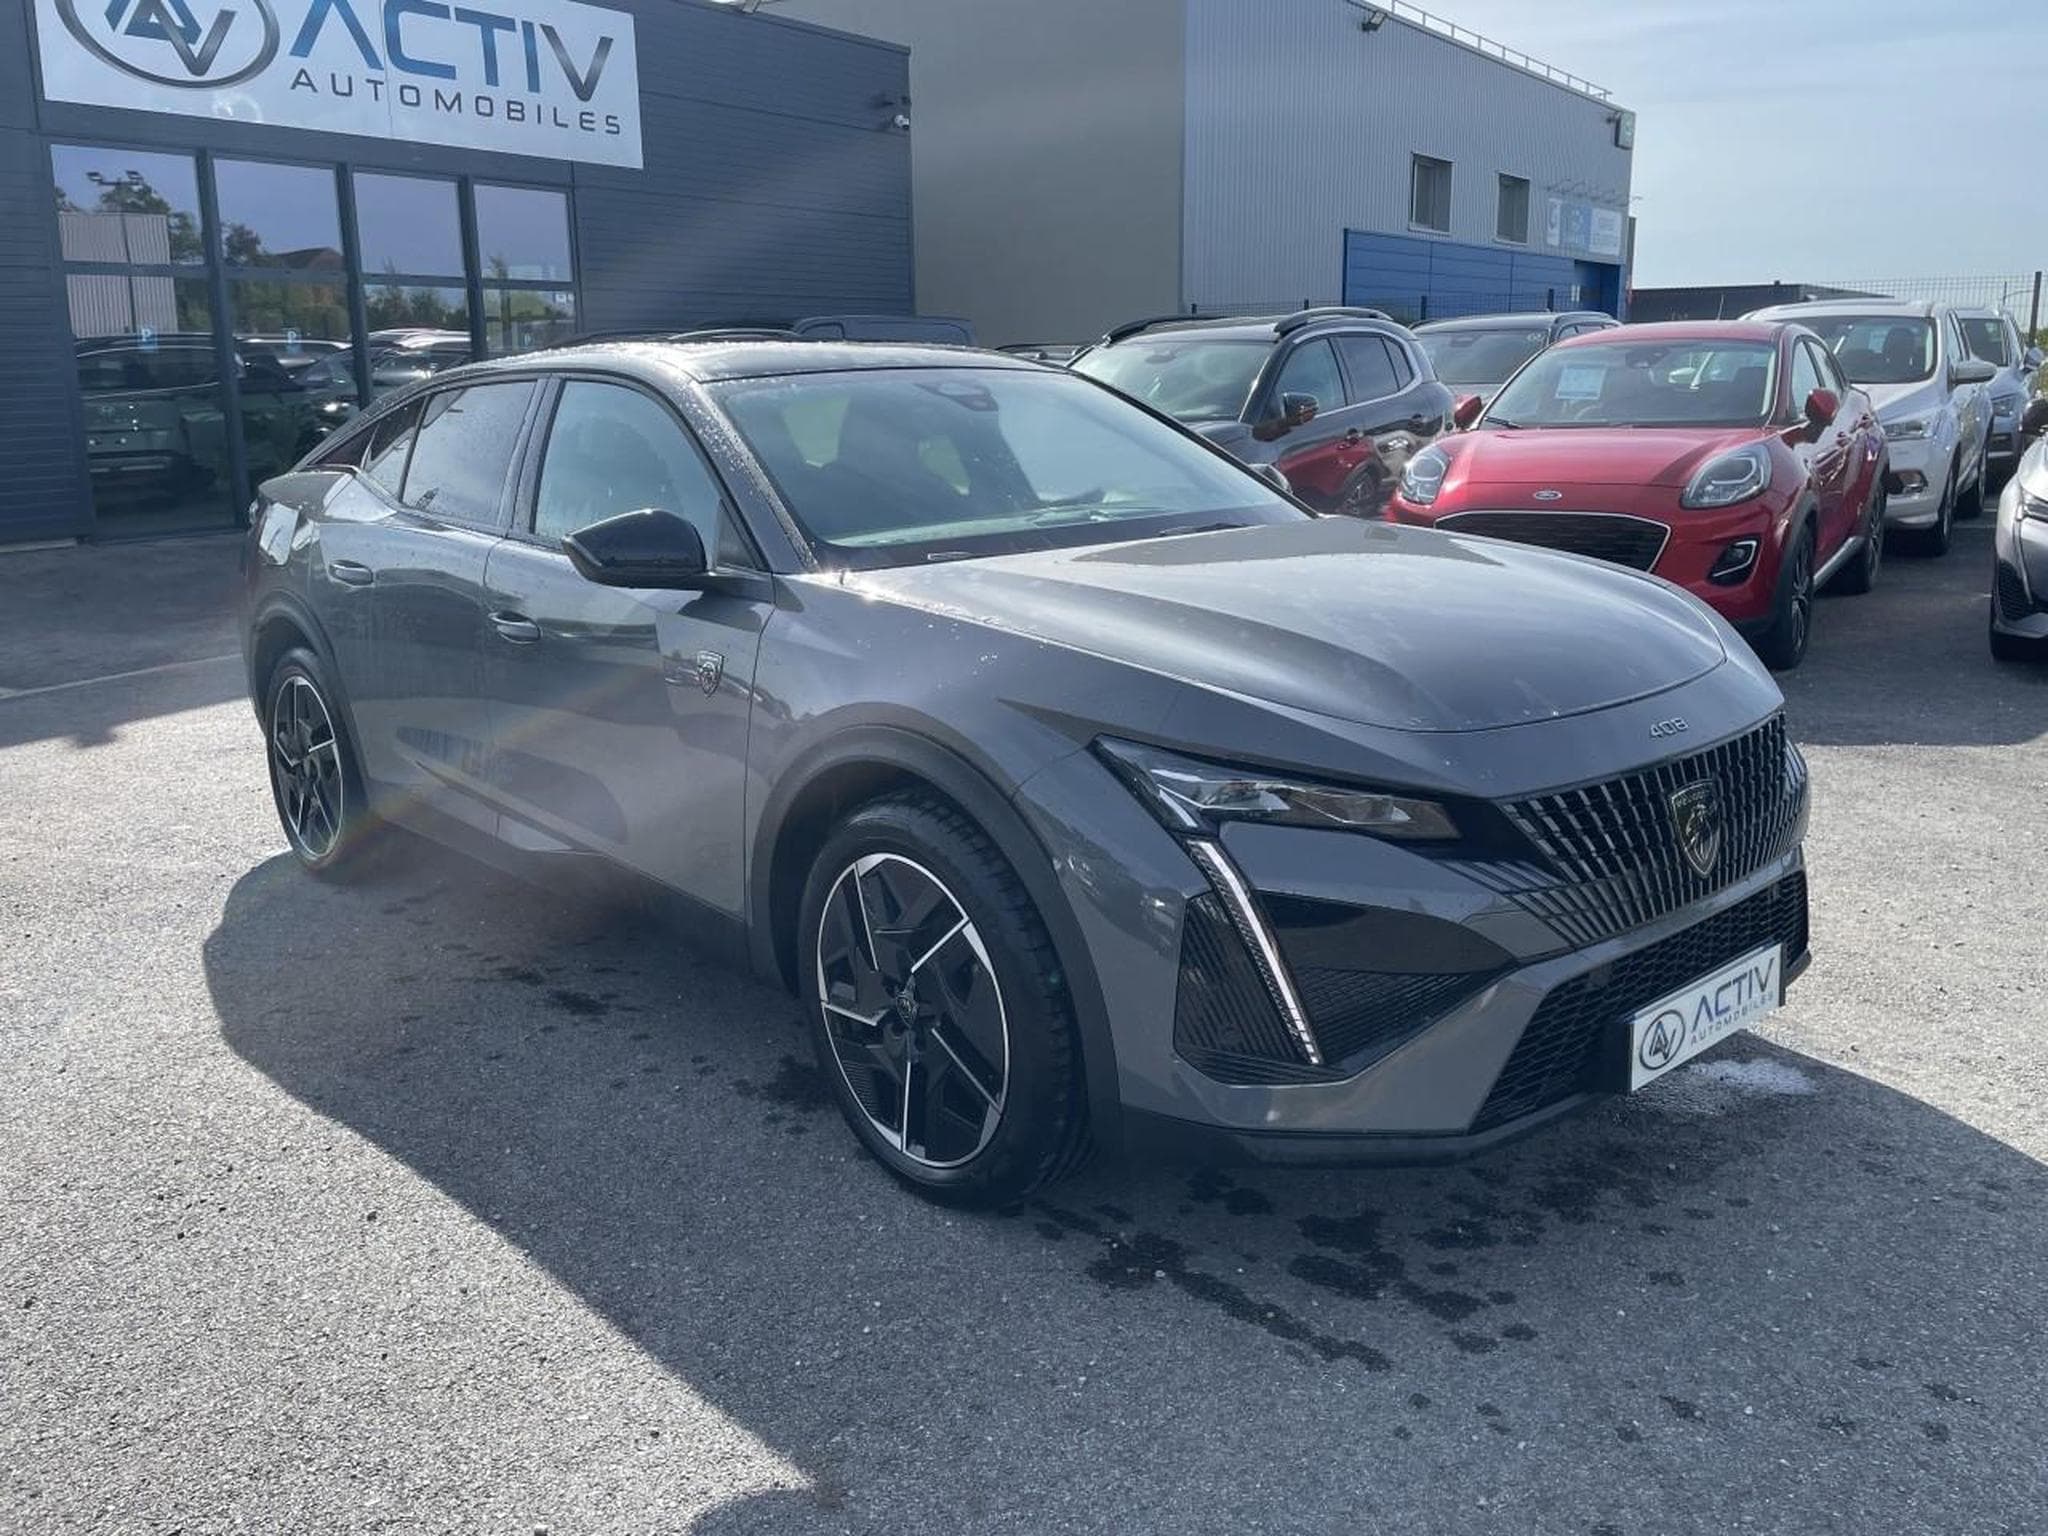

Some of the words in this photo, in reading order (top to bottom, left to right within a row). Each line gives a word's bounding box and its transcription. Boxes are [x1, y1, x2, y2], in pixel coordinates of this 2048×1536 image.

[289, 0, 614, 101] ACTIV
[290, 68, 621, 136] AUTOMOBILES
[1650, 717, 1689, 738] 408
[1690, 992, 1774, 1047] AUTOMOBILES
[1691, 957, 1775, 1033] ACTIV
